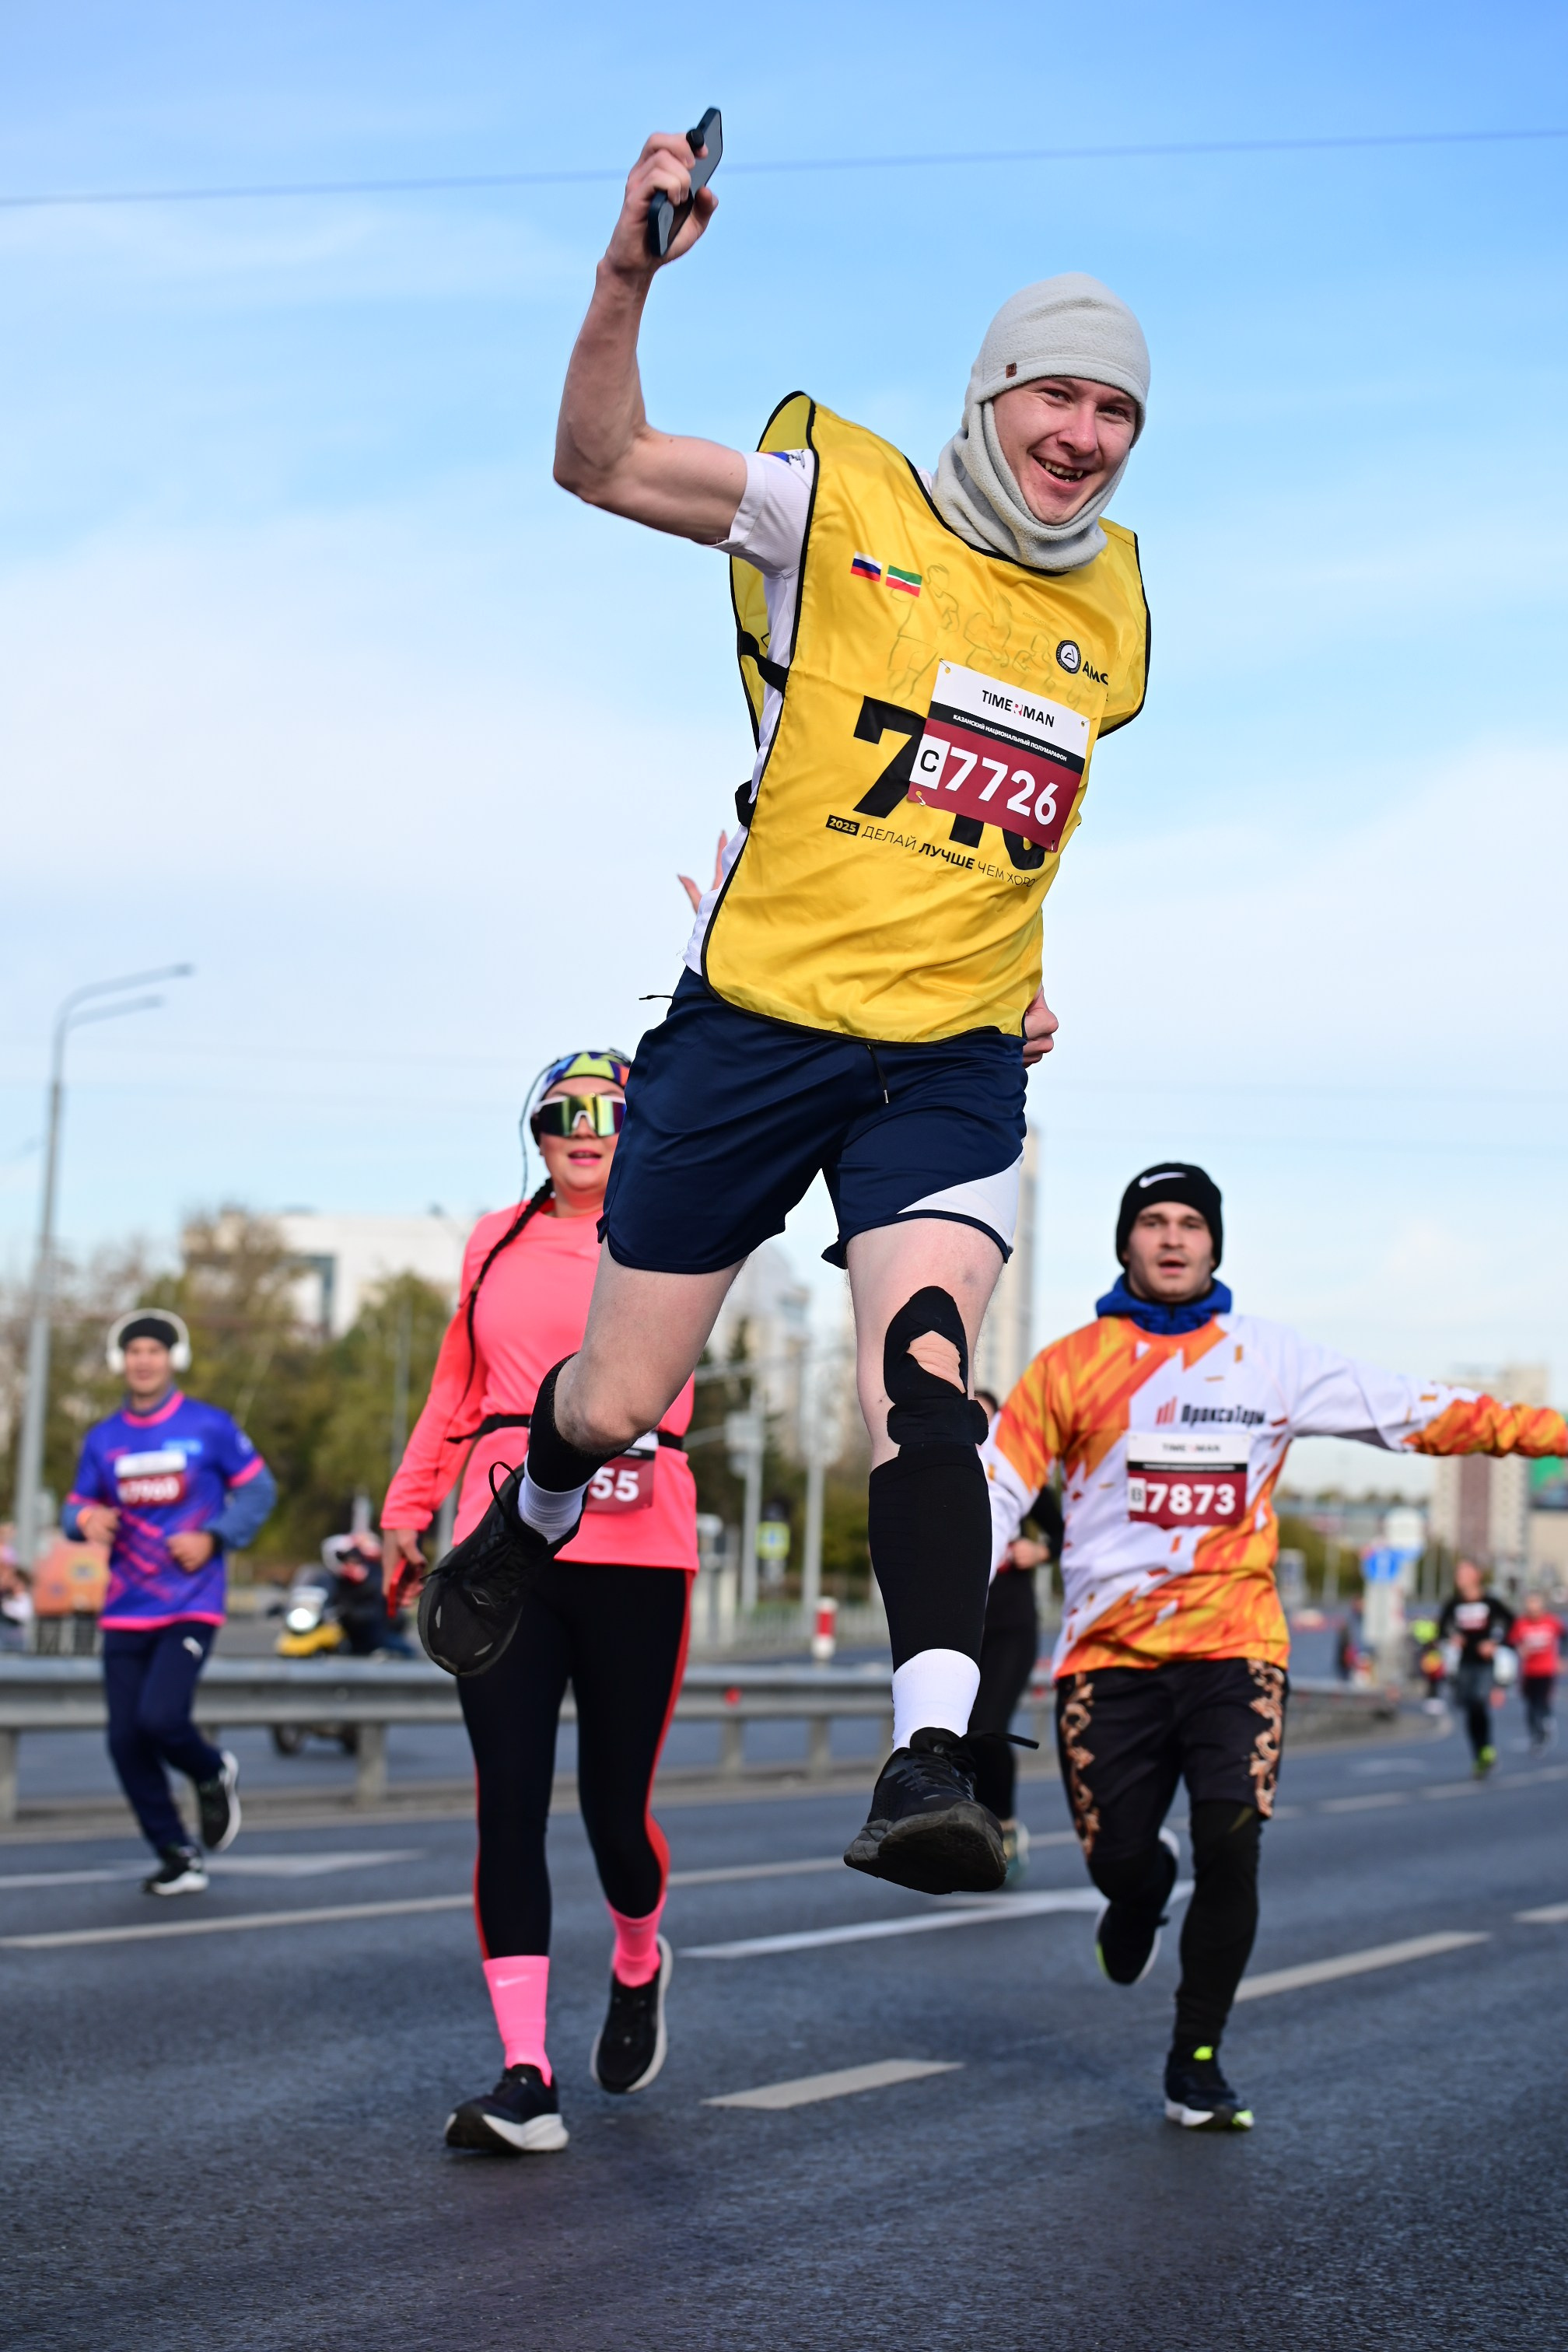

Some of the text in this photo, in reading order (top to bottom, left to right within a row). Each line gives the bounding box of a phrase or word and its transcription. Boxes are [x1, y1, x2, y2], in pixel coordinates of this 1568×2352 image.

[953, 714, 1067, 762] КАЗАНСКИЙ НАЦИОНАЛЬНЫЙ ПОЛУМАРАФОН
[945, 746, 1059, 825] 7726
[828, 817, 857, 833] 2025
[861, 825, 917, 851] ДЕЛАЙ
[918, 842, 975, 870] ЛУЧШЕ
[978, 860, 1004, 880] ЧЕМ
[1147, 1482, 1236, 1515] 7873
